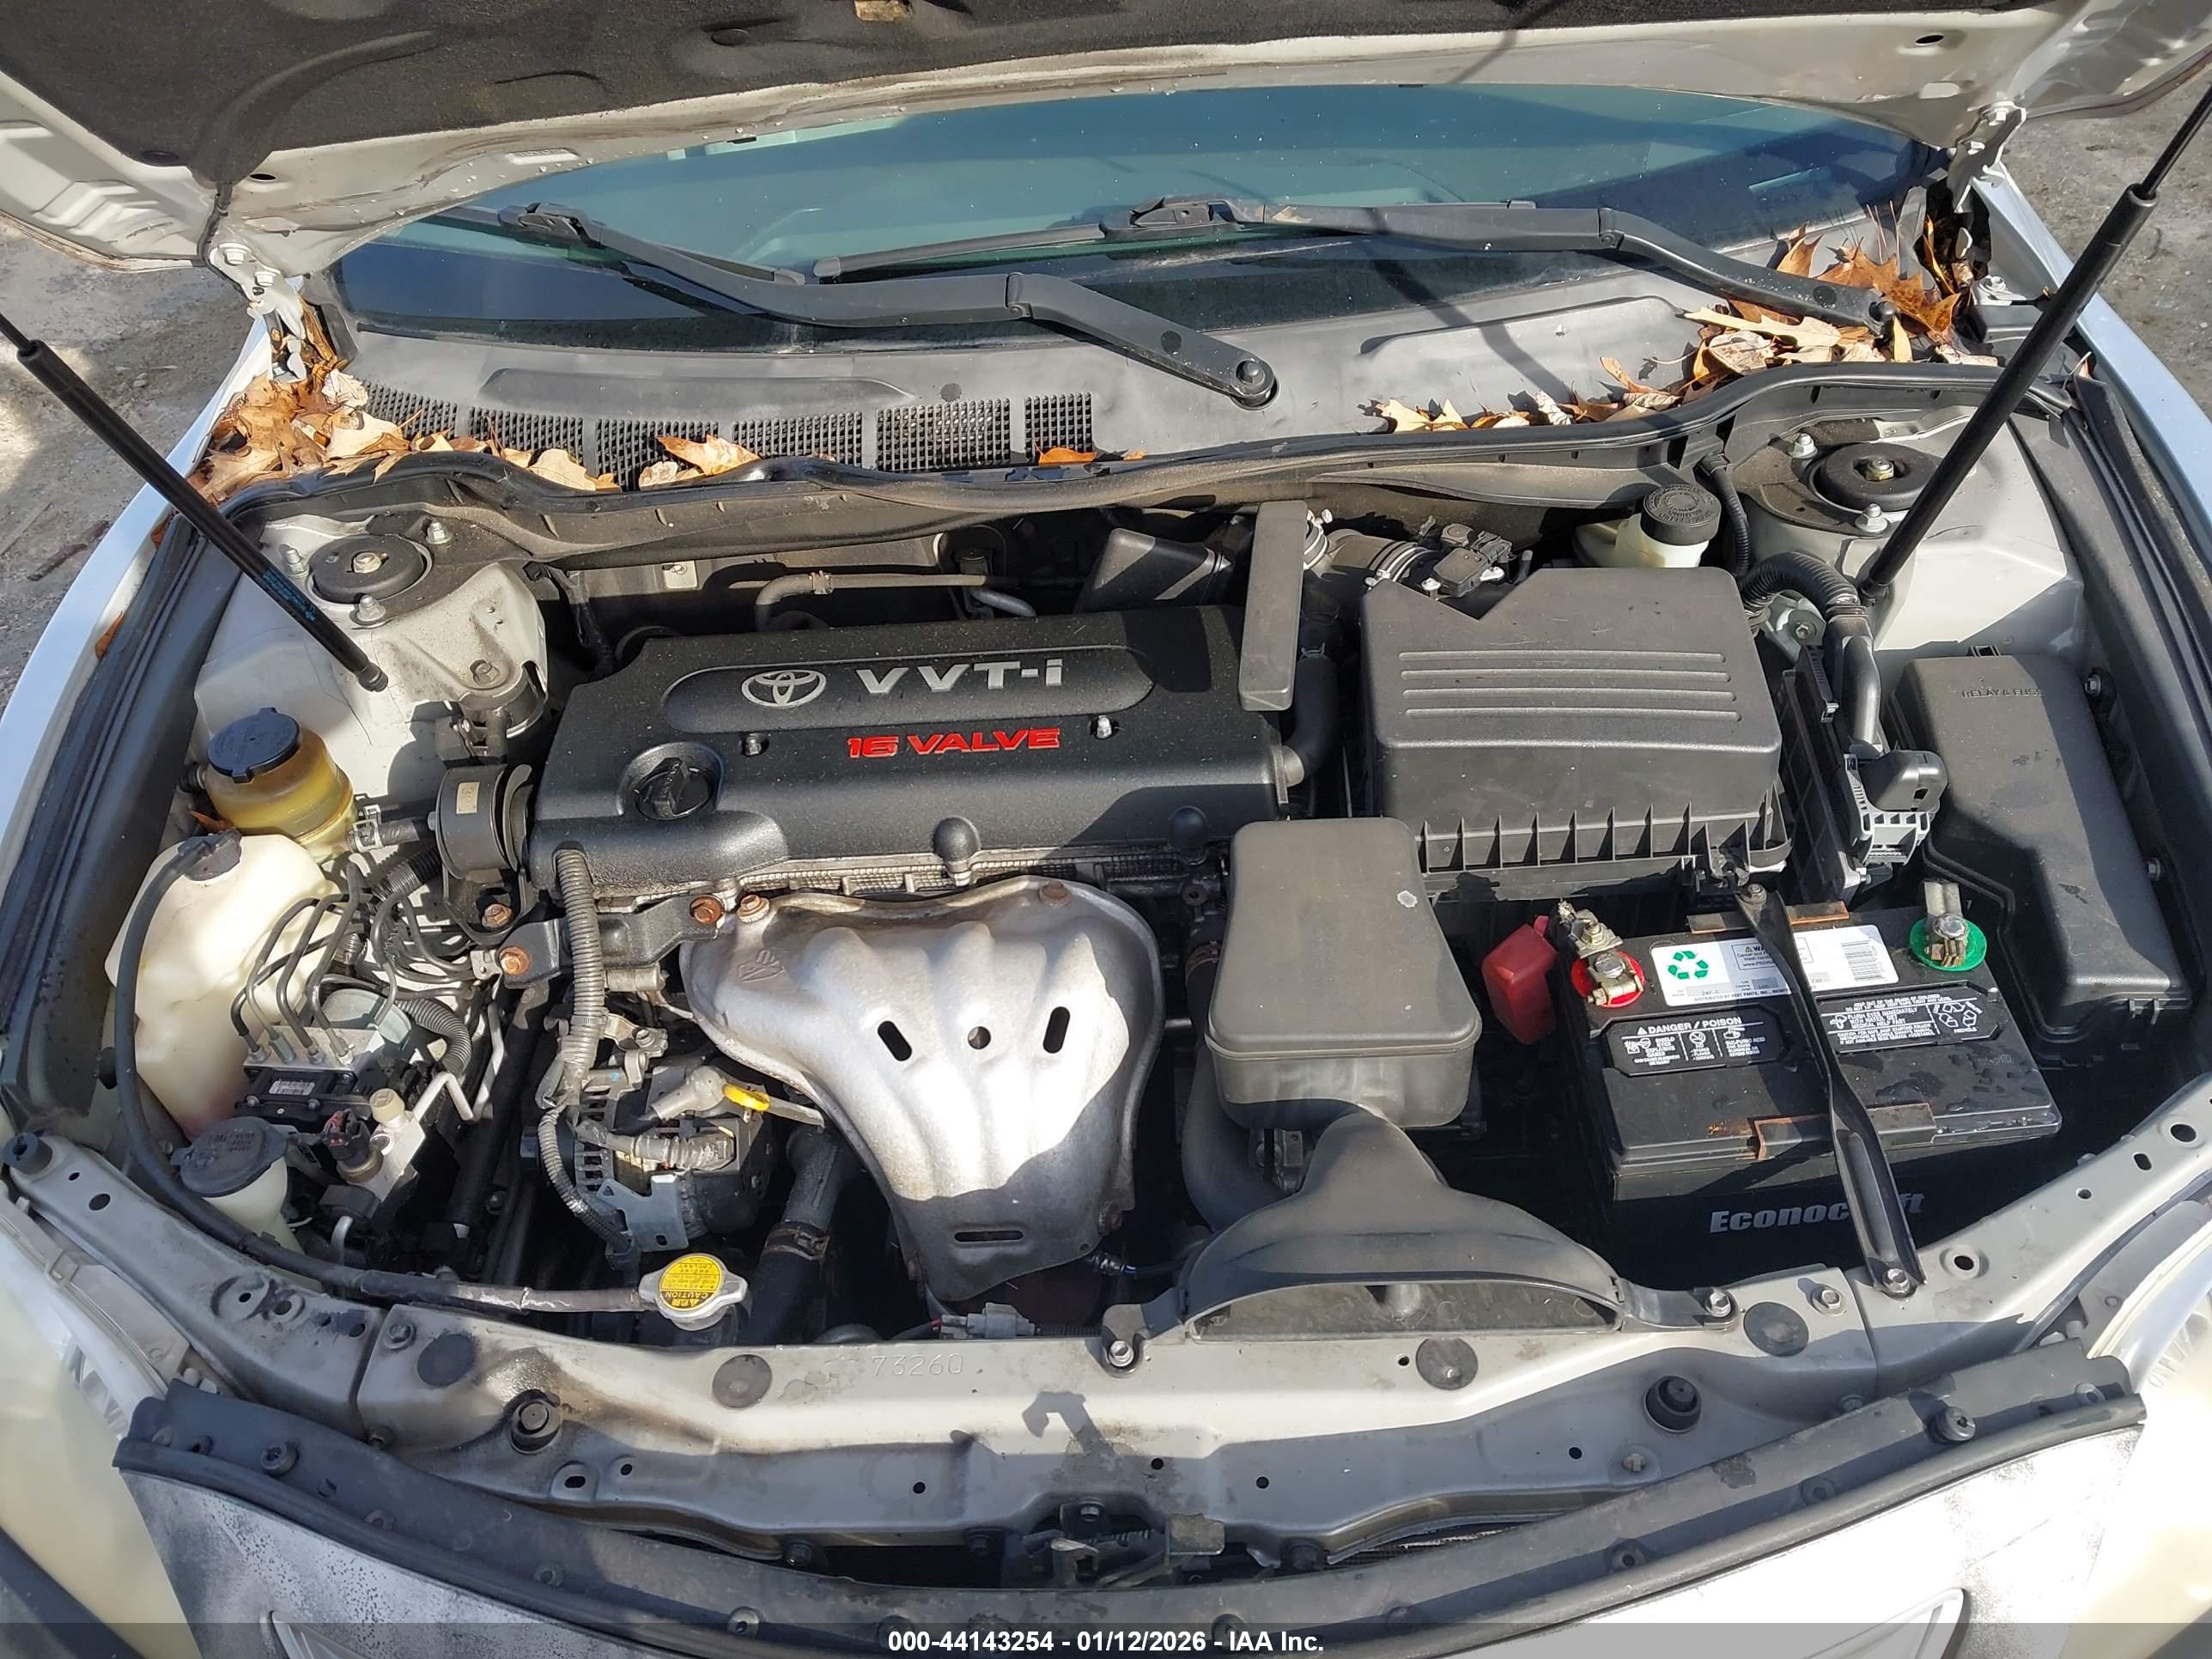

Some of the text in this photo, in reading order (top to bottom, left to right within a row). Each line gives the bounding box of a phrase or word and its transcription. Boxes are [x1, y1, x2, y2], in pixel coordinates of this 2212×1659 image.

[855, 659, 1063, 694] VVT-i
[1961, 688, 2000, 697] RELAY
[848, 728, 1060, 758] 16 VALVE
[1648, 1021, 1692, 1034] DANGER
[1702, 1017, 1742, 1028] POISON
[1710, 1193, 1925, 1233] Econocft
[665, 1291, 708, 1299] CAUTION
[872, 1352, 963, 1377] 73260
